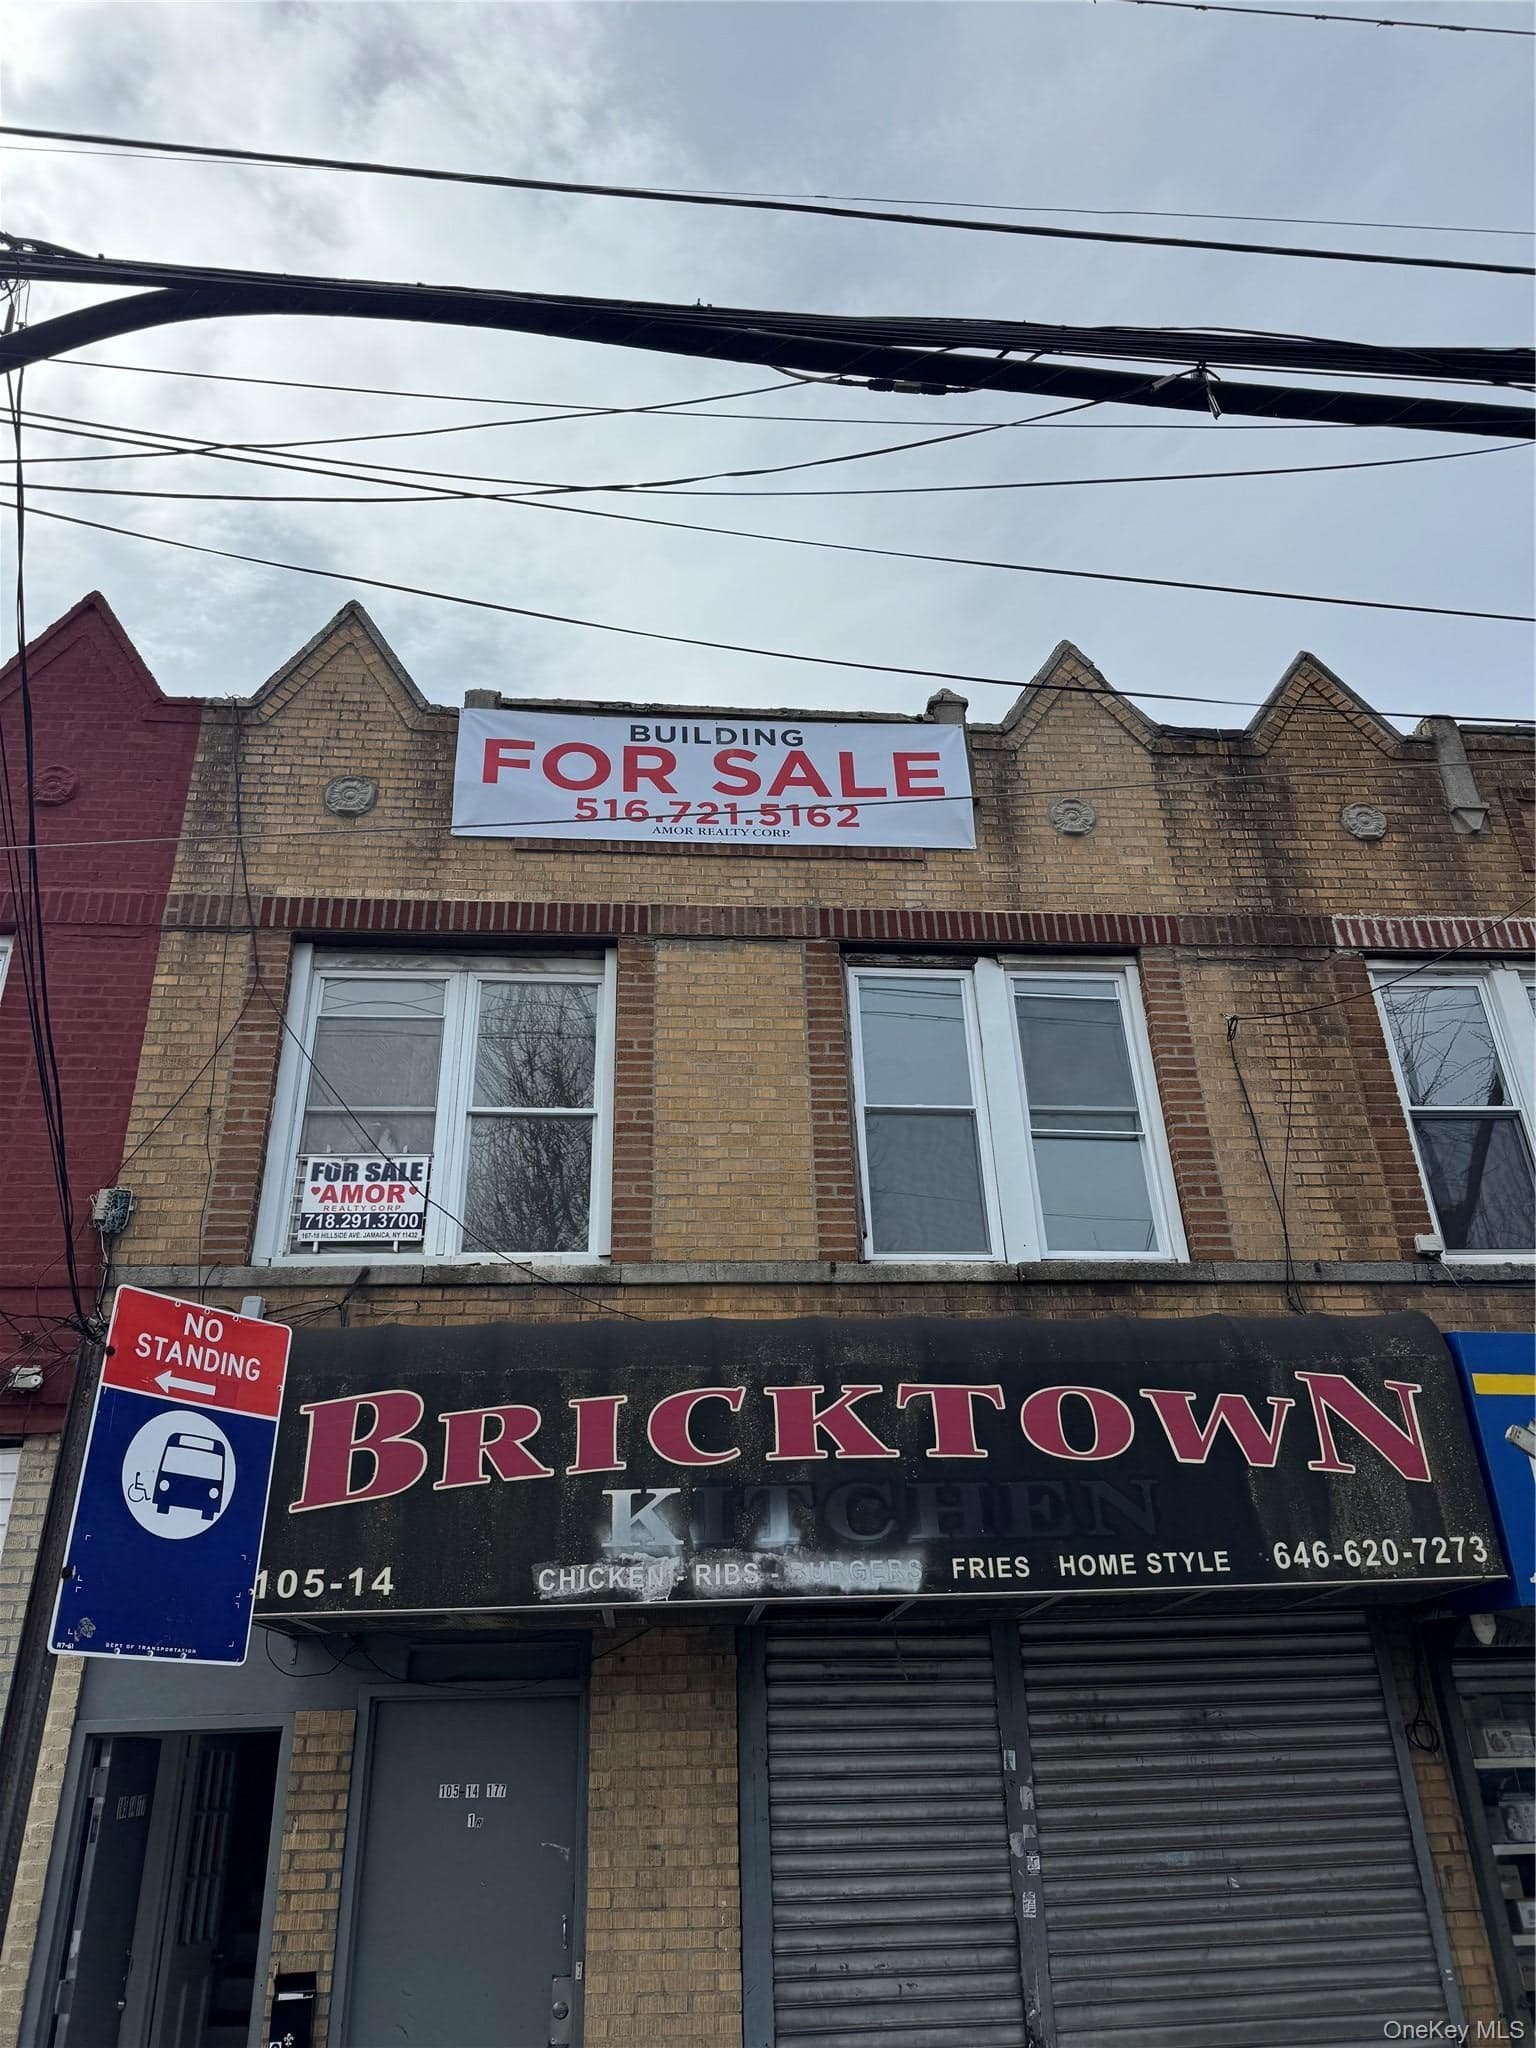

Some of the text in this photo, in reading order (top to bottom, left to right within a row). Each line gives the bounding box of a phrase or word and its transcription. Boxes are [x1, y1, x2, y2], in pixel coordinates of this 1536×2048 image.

[630, 724, 803, 746] BUILDING
[482, 738, 946, 798] FOR SALE
[575, 798, 860, 828] 516.721.5162
[652, 826, 791, 838] AMOR REALTY CORP.
[310, 1162, 423, 1182] FOR SALE
[318, 1184, 406, 1204] AMOR
[304, 1213, 419, 1229] 718.291.3700
[183, 1312, 224, 1343] NO
[135, 1332, 261, 1381] STANDING
[288, 1370, 1434, 1514] BRICKTOWN
[601, 1479, 1161, 1549] KITCHEN
[255, 1567, 394, 1600] 105-14
[538, 1564, 664, 1591] CHICKEN
[695, 1562, 760, 1586] RIBS
[952, 1555, 1031, 1580] FRIES
[1059, 1552, 1137, 1577] HOME
[1147, 1550, 1231, 1574] STYLE
[1273, 1535, 1489, 1570] 646-620-7273
[106, 1641, 123, 1649] DEPT
[137, 1644, 196, 1654] TRANSPORTATION
